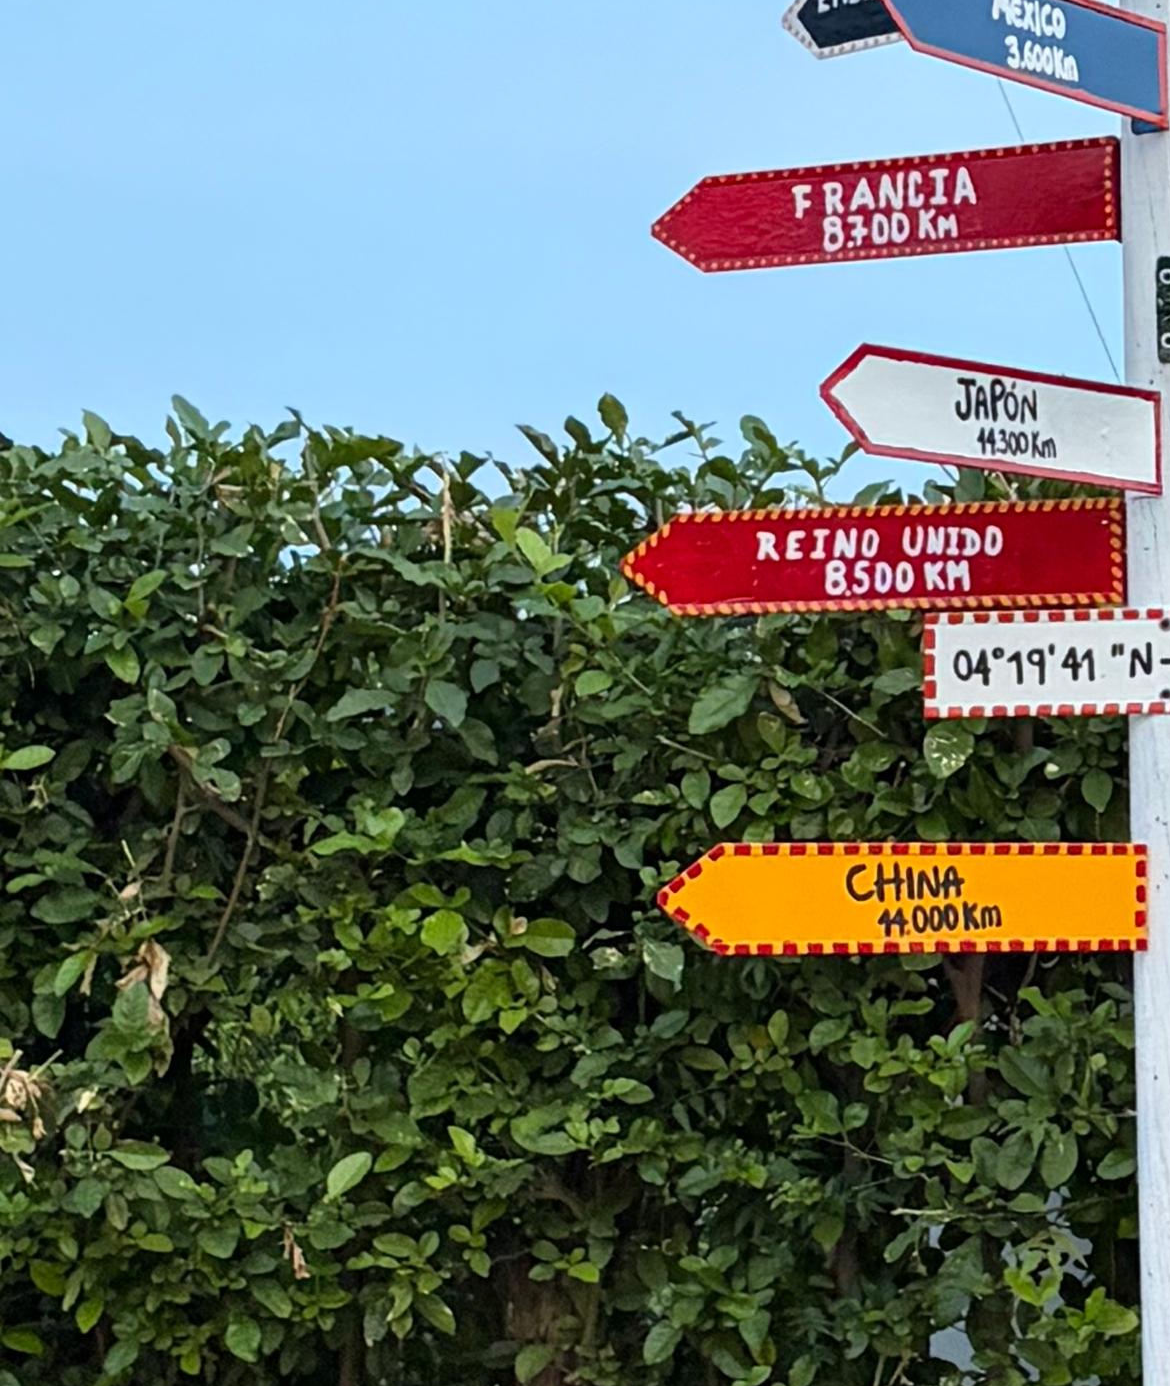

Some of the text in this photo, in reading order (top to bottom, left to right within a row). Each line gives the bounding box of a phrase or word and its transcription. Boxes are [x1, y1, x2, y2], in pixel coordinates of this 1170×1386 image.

[791, 166, 977, 219] FRANCIA
[955, 377, 1037, 424] JAPÓN
[756, 525, 1003, 561] REINO UNIDO
[846, 861, 965, 902] CHINA
